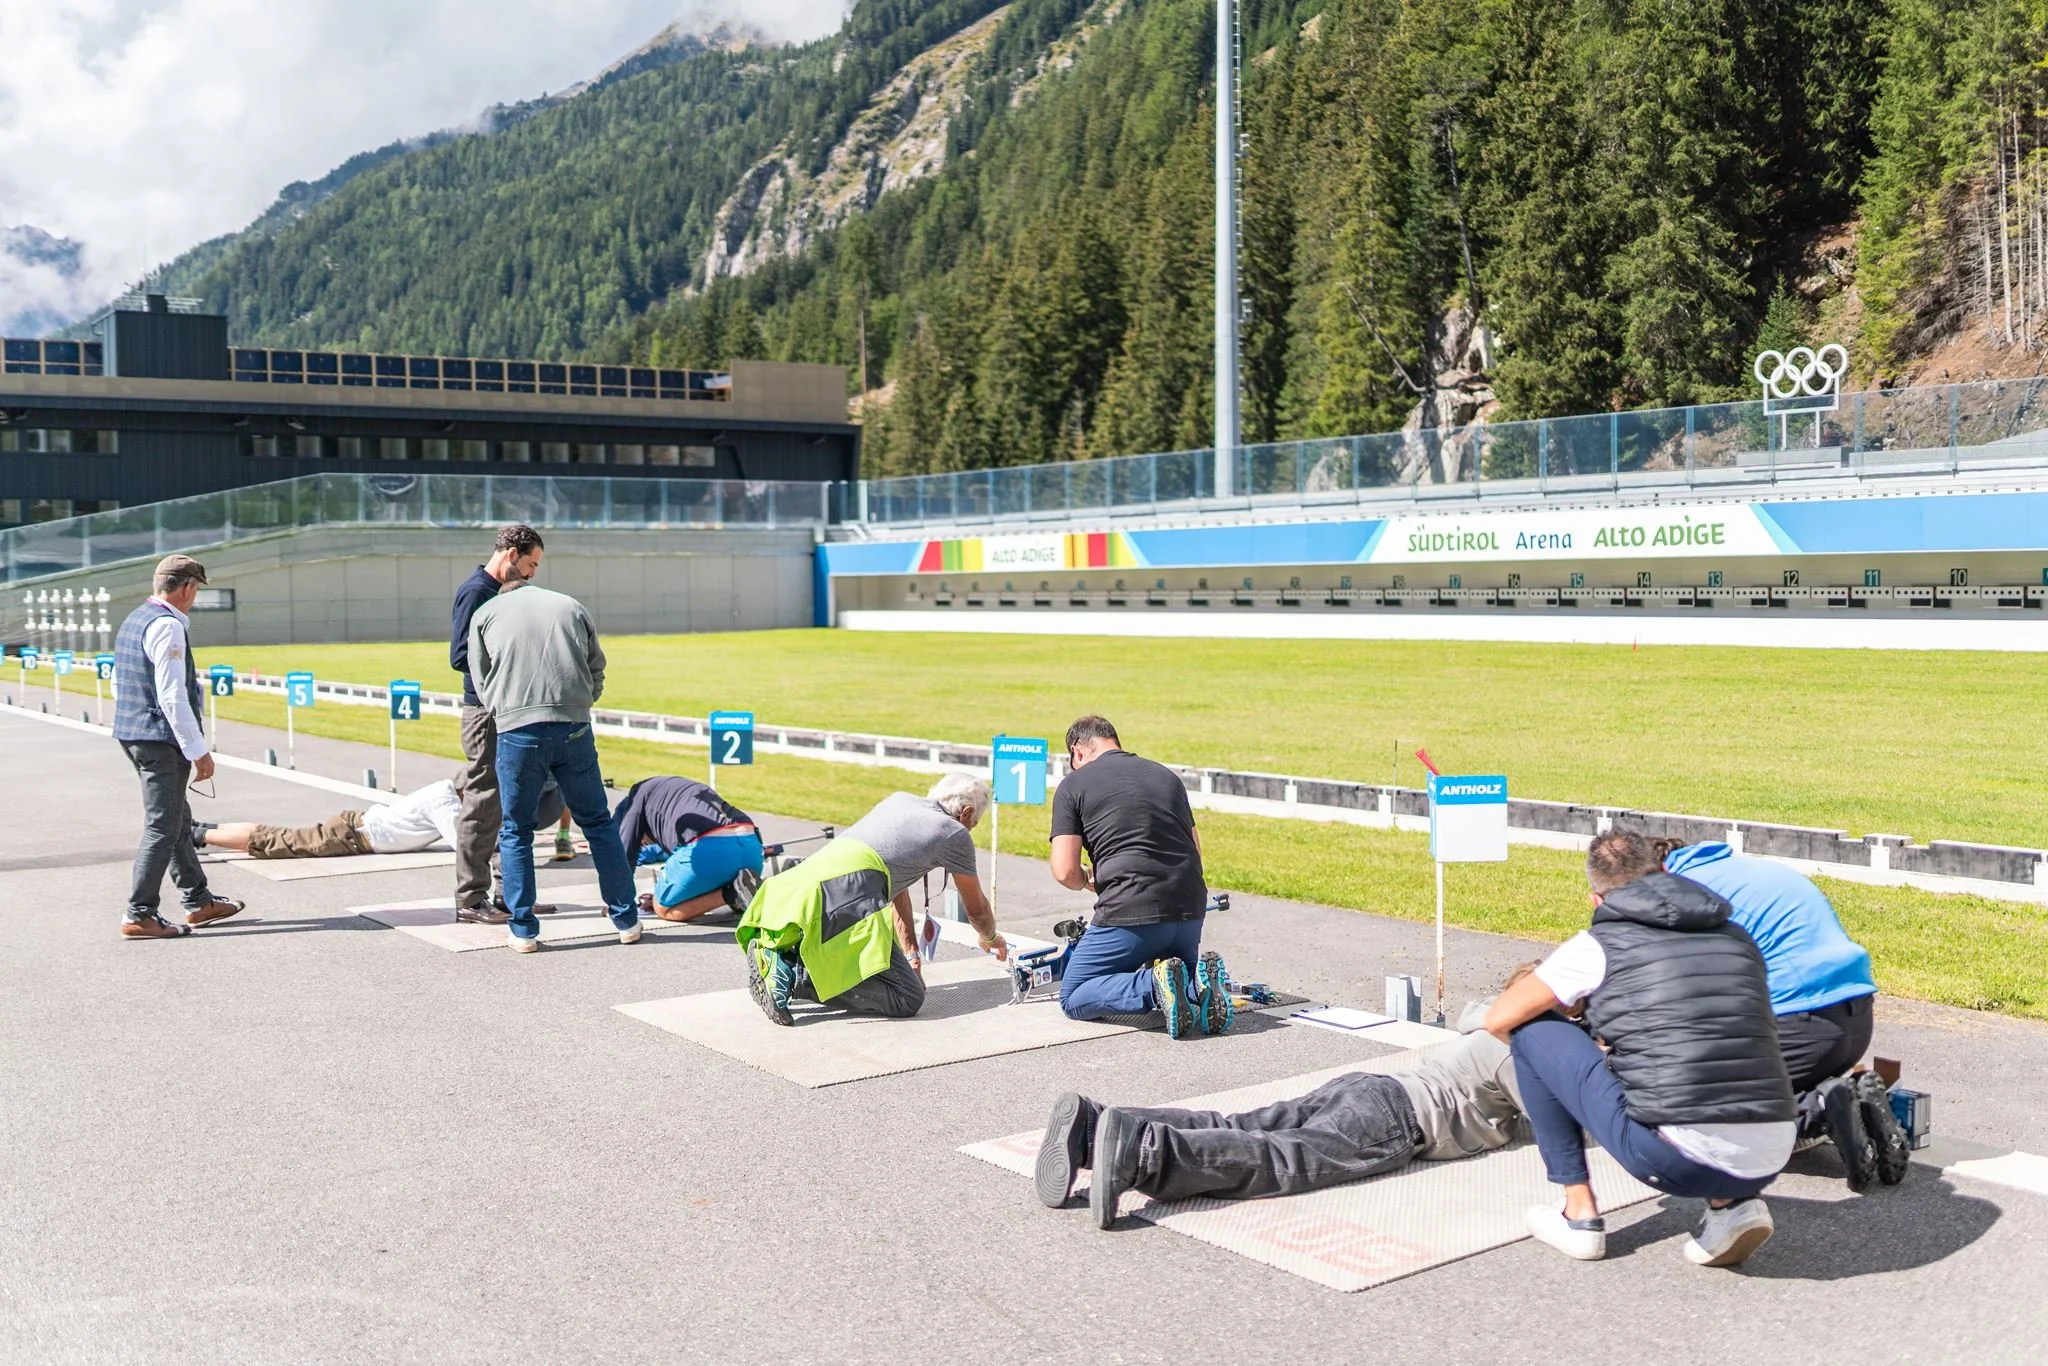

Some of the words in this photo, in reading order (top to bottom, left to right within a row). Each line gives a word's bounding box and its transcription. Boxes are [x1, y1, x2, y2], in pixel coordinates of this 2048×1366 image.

[1516, 532, 1572, 550] Arena
[1509, 573, 1519, 587] 16
[1572, 574, 1582, 587] 15
[1638, 573, 1650, 587] 14
[1709, 572, 1721, 586] 13
[1785, 571, 1798, 586] 12
[1866, 571, 1878, 586] 11
[1951, 570, 1966, 586] 10
[101, 663, 111, 679] 8
[216, 676, 229, 695] 6
[295, 684, 307, 705] 5
[397, 695, 413, 719] 4
[722, 730, 741, 764] 2
[998, 744, 1042, 754] ANTHOLZ
[1010, 762, 1027, 802] 1
[1440, 784, 1502, 796] ANTHOLZ
